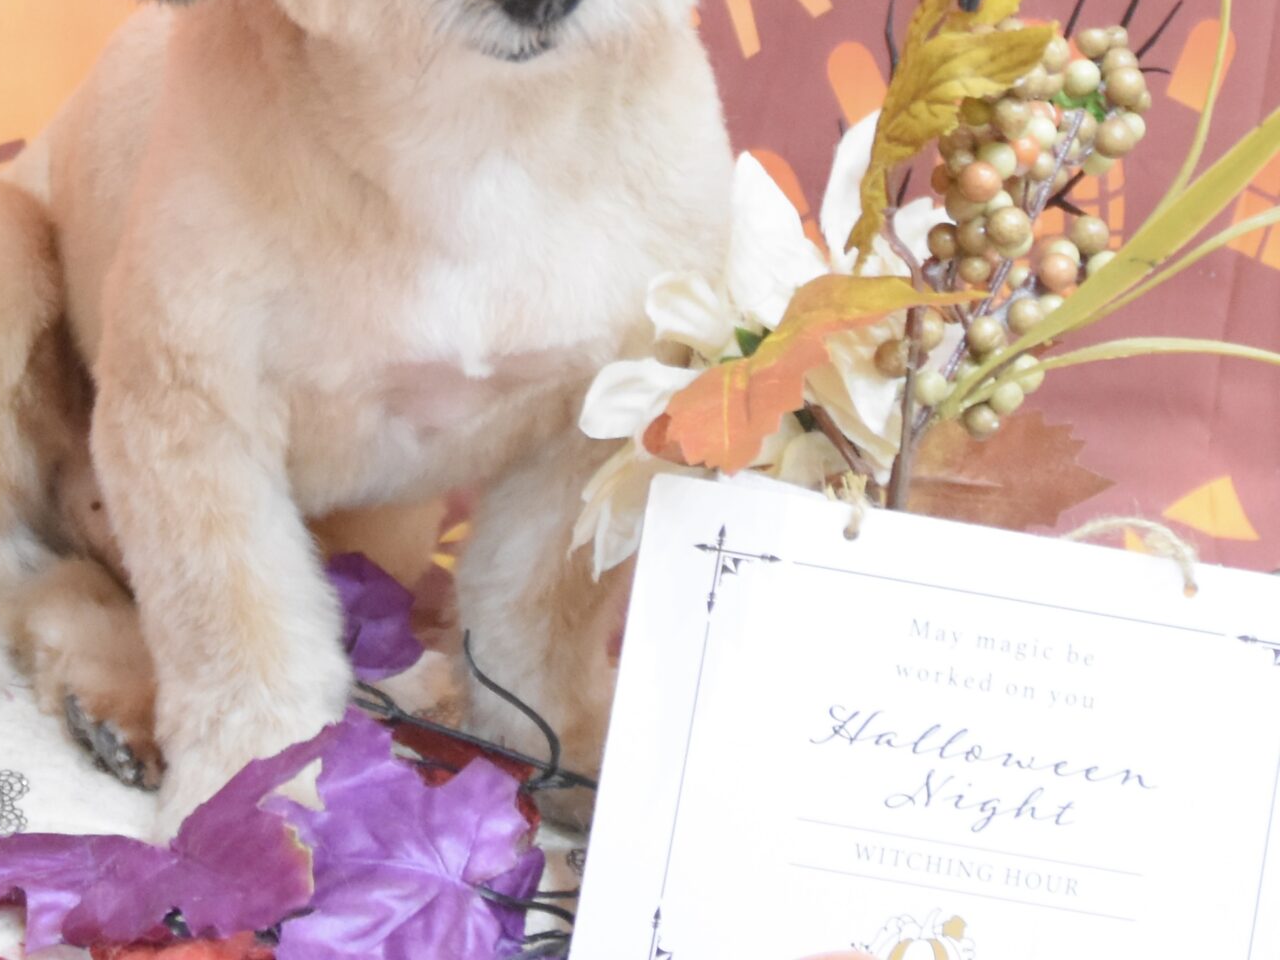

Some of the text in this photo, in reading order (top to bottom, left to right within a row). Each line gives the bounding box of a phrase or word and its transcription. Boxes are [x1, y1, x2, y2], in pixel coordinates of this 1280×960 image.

[909, 617, 1095, 667] May magic be
[895, 663, 1095, 711] worked on you
[808, 703, 1158, 791] Halloween
[883, 768, 1076, 833] Night
[854, 841, 1080, 898] WITCHING HOUR
